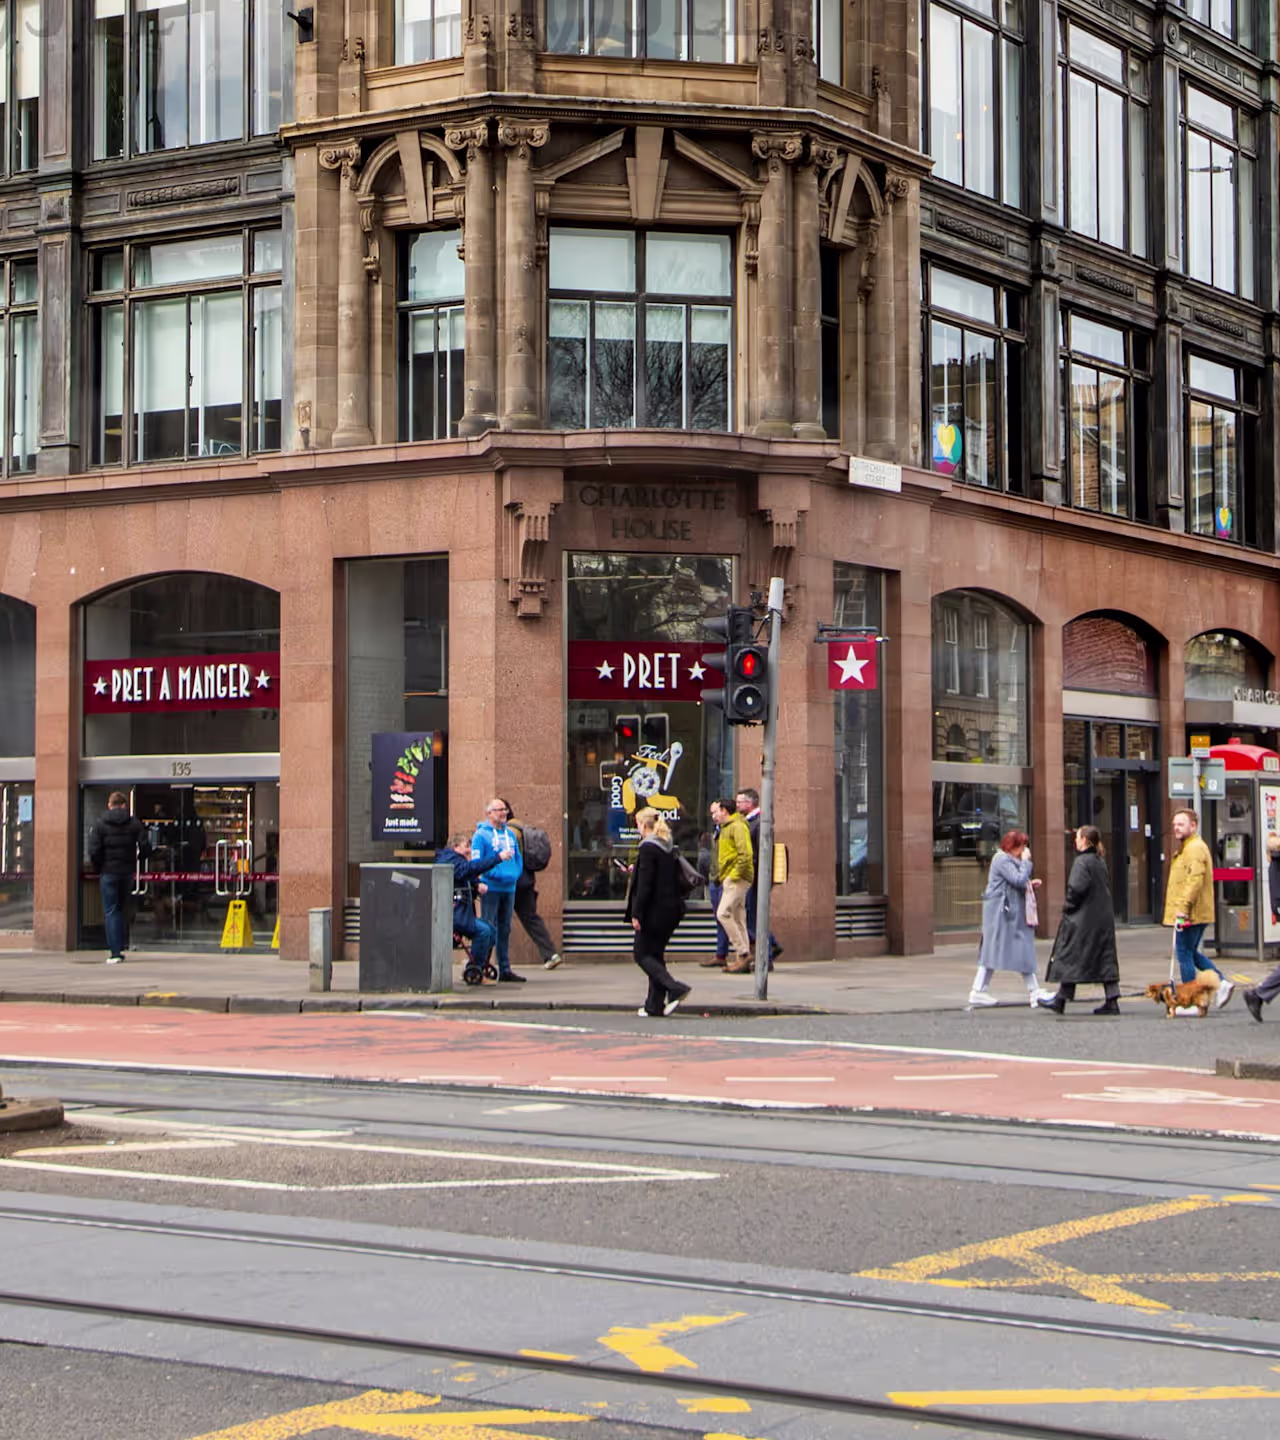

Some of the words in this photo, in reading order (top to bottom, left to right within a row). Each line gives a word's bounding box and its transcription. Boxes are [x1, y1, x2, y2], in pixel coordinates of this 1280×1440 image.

[579, 485, 726, 510] CHARLOTTE
[611, 518, 692, 541] HOUSE
[111, 667, 154, 702] PRET
[159, 667, 171, 701] A
[178, 663, 251, 700] MANGER
[624, 652, 681, 689] PRET
[636, 744, 670, 760] Feel
[171, 762, 192, 777] 135
[611, 776, 624, 808] Good
[385, 817, 399, 827] Just
[399, 817, 419, 827] made
